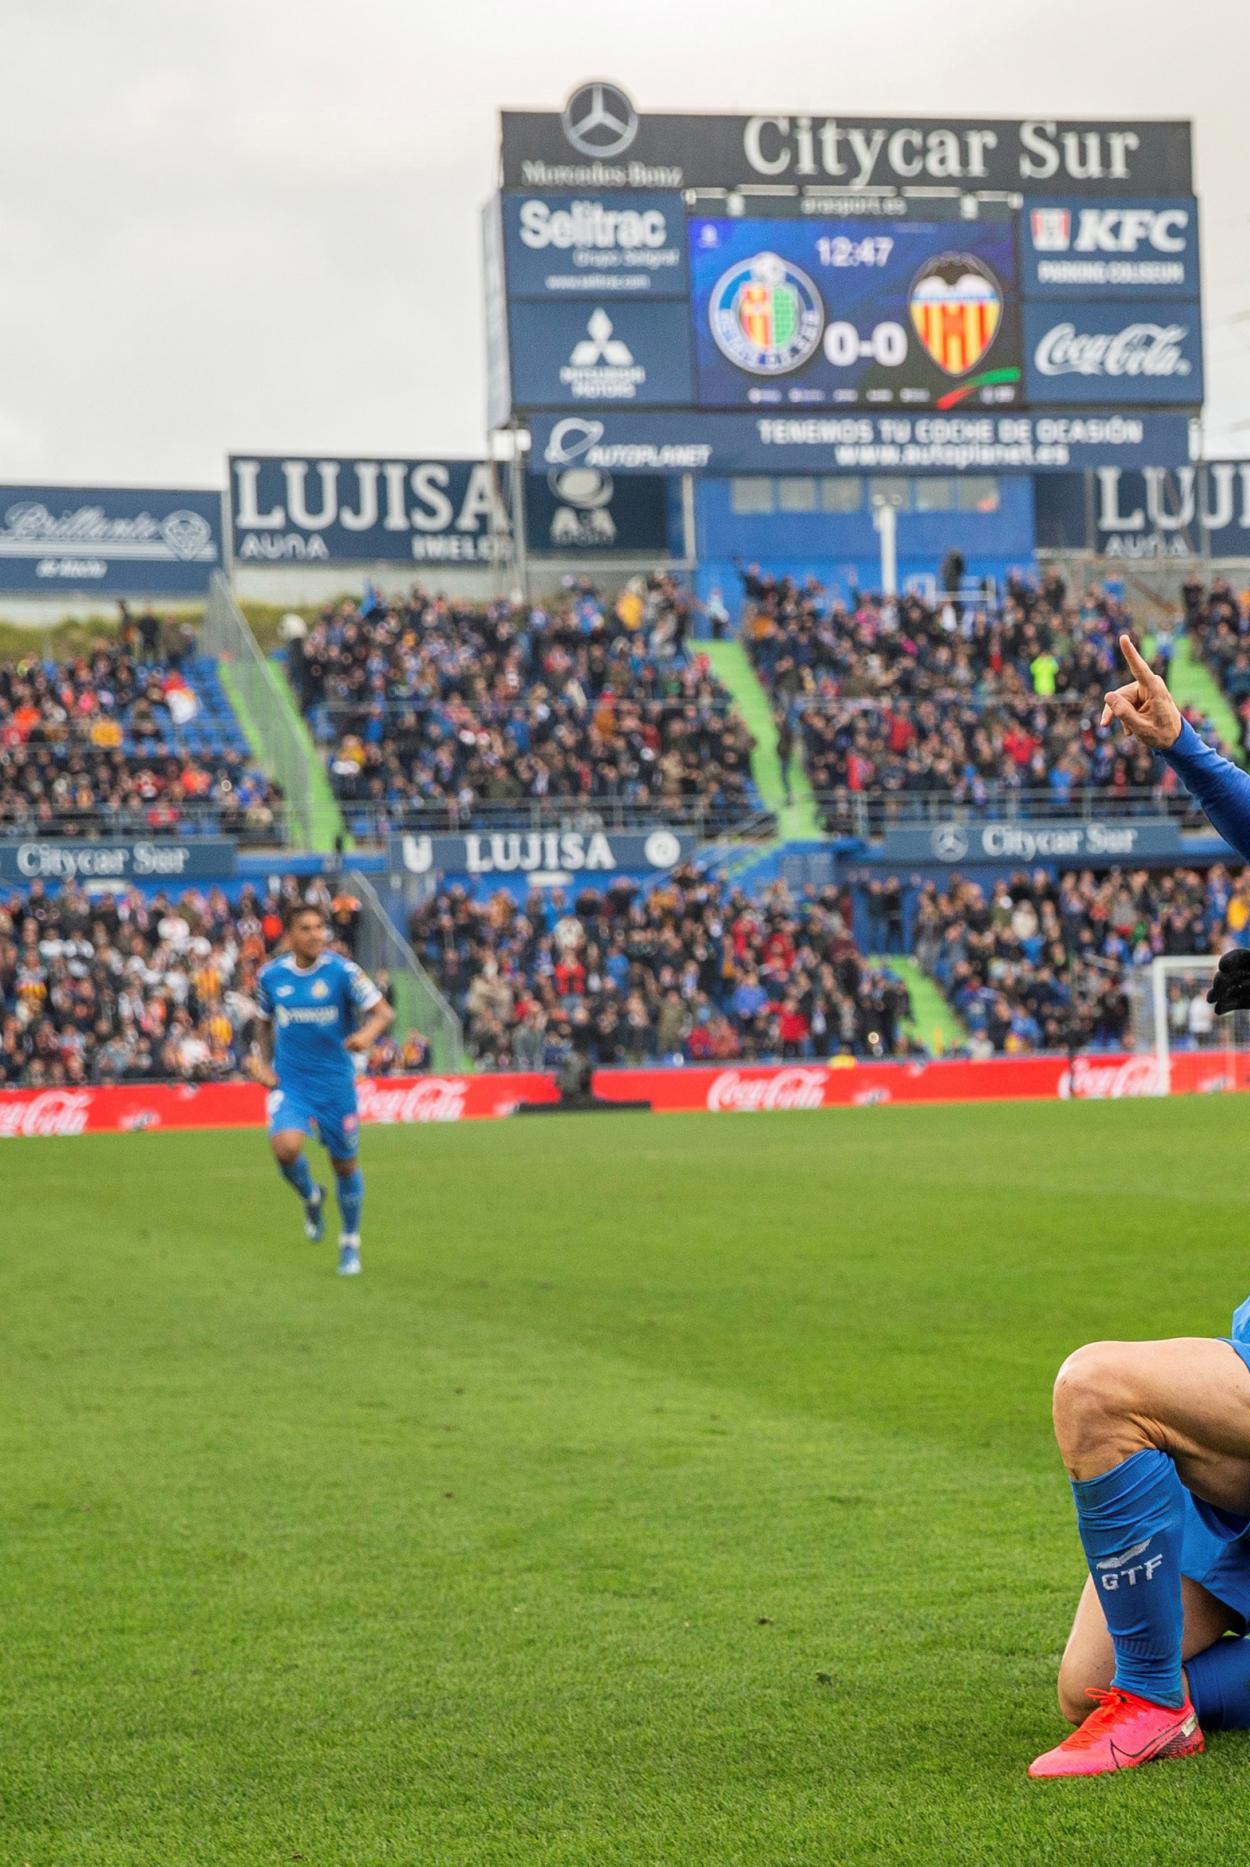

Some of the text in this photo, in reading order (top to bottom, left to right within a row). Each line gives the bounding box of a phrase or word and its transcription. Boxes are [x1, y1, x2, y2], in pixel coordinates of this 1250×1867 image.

[743, 117, 1140, 190] Citycar Sur
[521, 160, 684, 188] Mercedes-Benz
[1074, 208, 1189, 253] KFC
[815, 236, 894, 267] 12:47
[824, 321, 908, 367] 0-0
[1035, 323, 1188, 376] Coca-Cola
[757, 415, 1144, 444] TENEMOS TU COCHE DE OCASIÓN
[585, 444, 713, 468] AUTOPLANET
[834, 444, 1070, 469] www.autoplanet.es
[234, 460, 512, 531] LUJISA
[16, 841, 190, 881] Citycar Sur
[465, 832, 617, 873] LUJISA
[980, 822, 1139, 861] Citycar Sur
[1101, 1553, 1163, 1591] GTF
